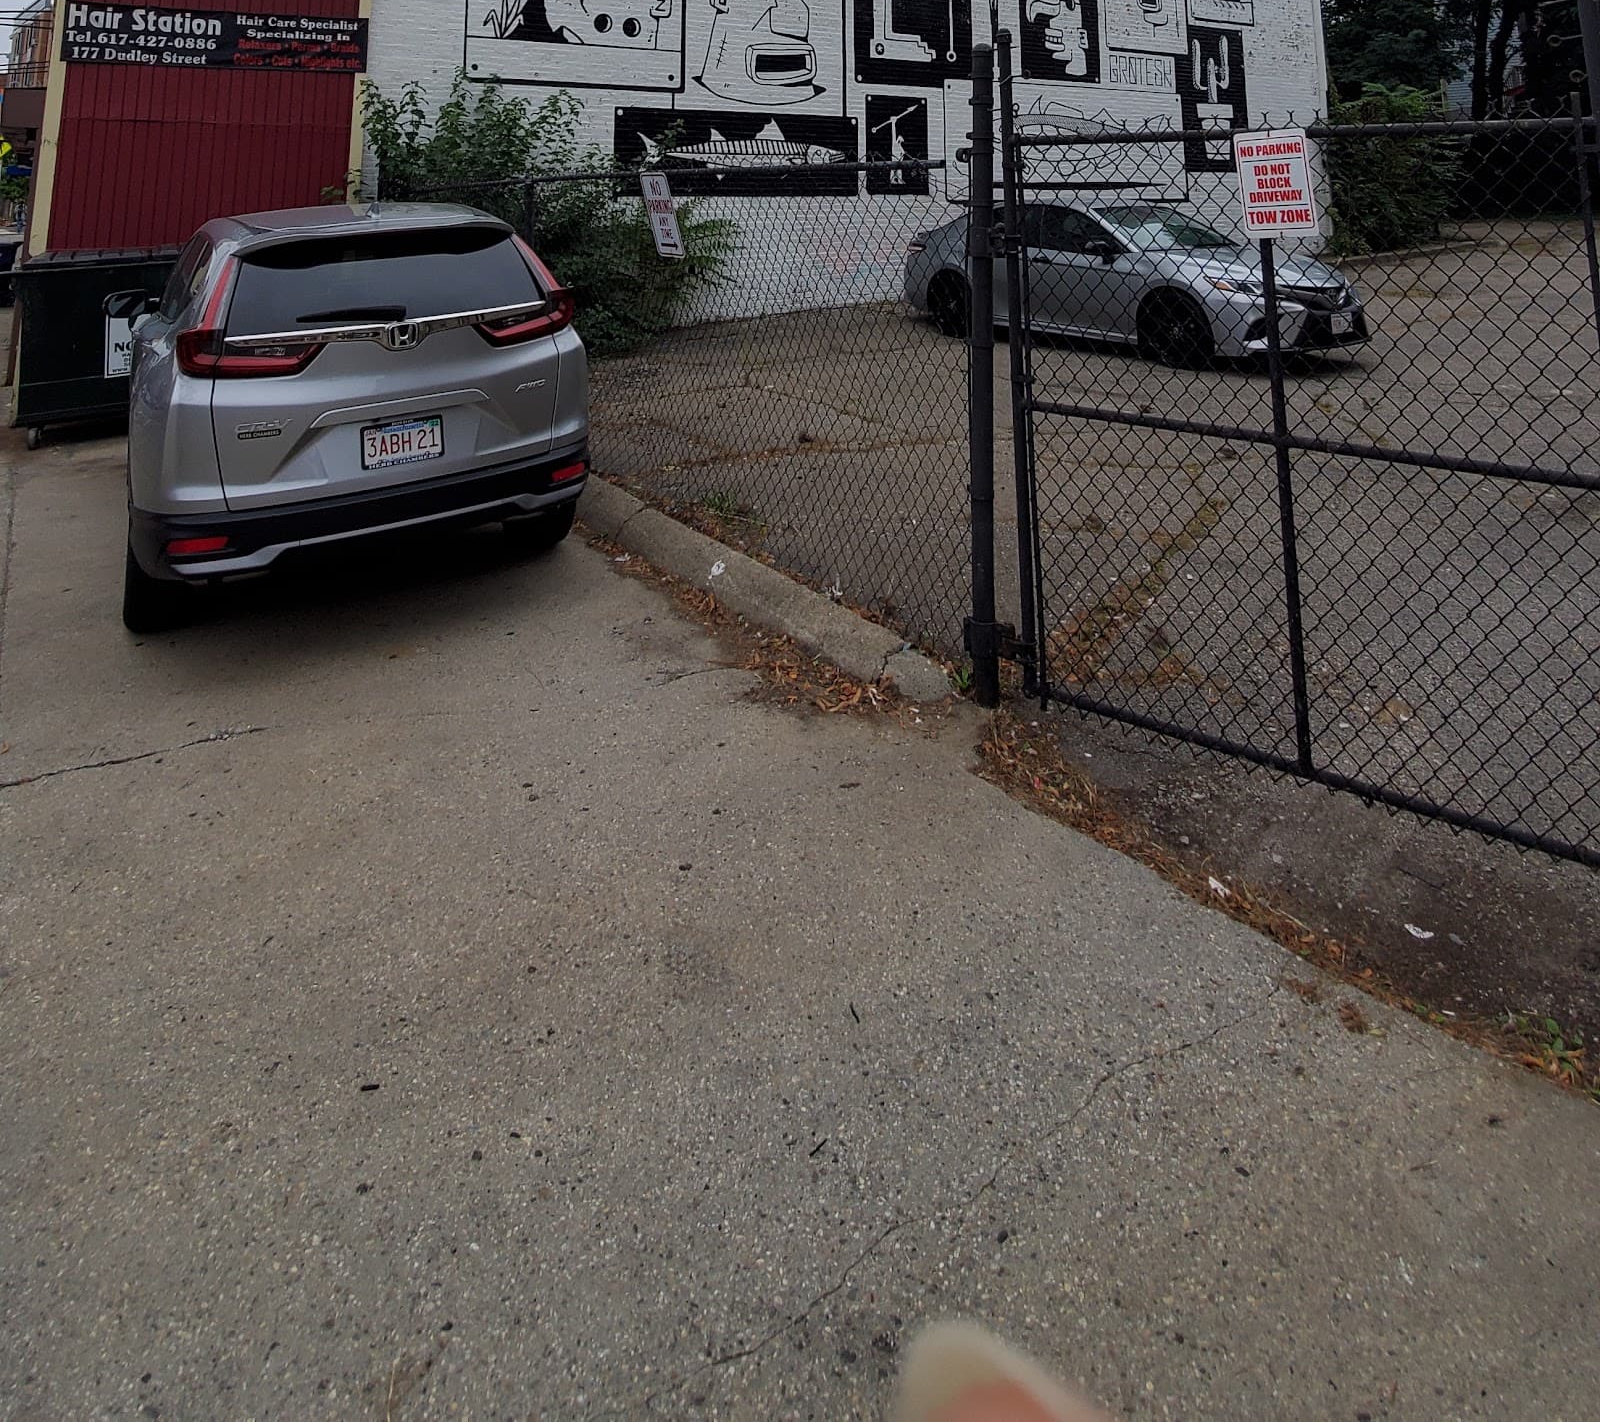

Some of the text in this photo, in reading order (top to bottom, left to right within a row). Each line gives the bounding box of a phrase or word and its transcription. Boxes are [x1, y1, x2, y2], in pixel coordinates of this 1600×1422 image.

[68, 3, 222, 36] Hair Station
[236, 15, 358, 31] Hair Care Specialist
[246, 29, 351, 42] Specializing In
[71, 46, 207, 65] 177 Dudley Street
[1240, 142, 1302, 158] NO PARKING
[1253, 163, 1292, 177] DO NOT
[650, 178, 662, 196] NO
[1257, 176, 1292, 189] BLOCK
[1249, 189, 1303, 203] DRIVEWAY
[1248, 208, 1312, 225] TOW ZONE
[366, 427, 440, 458] 3ABH 21
